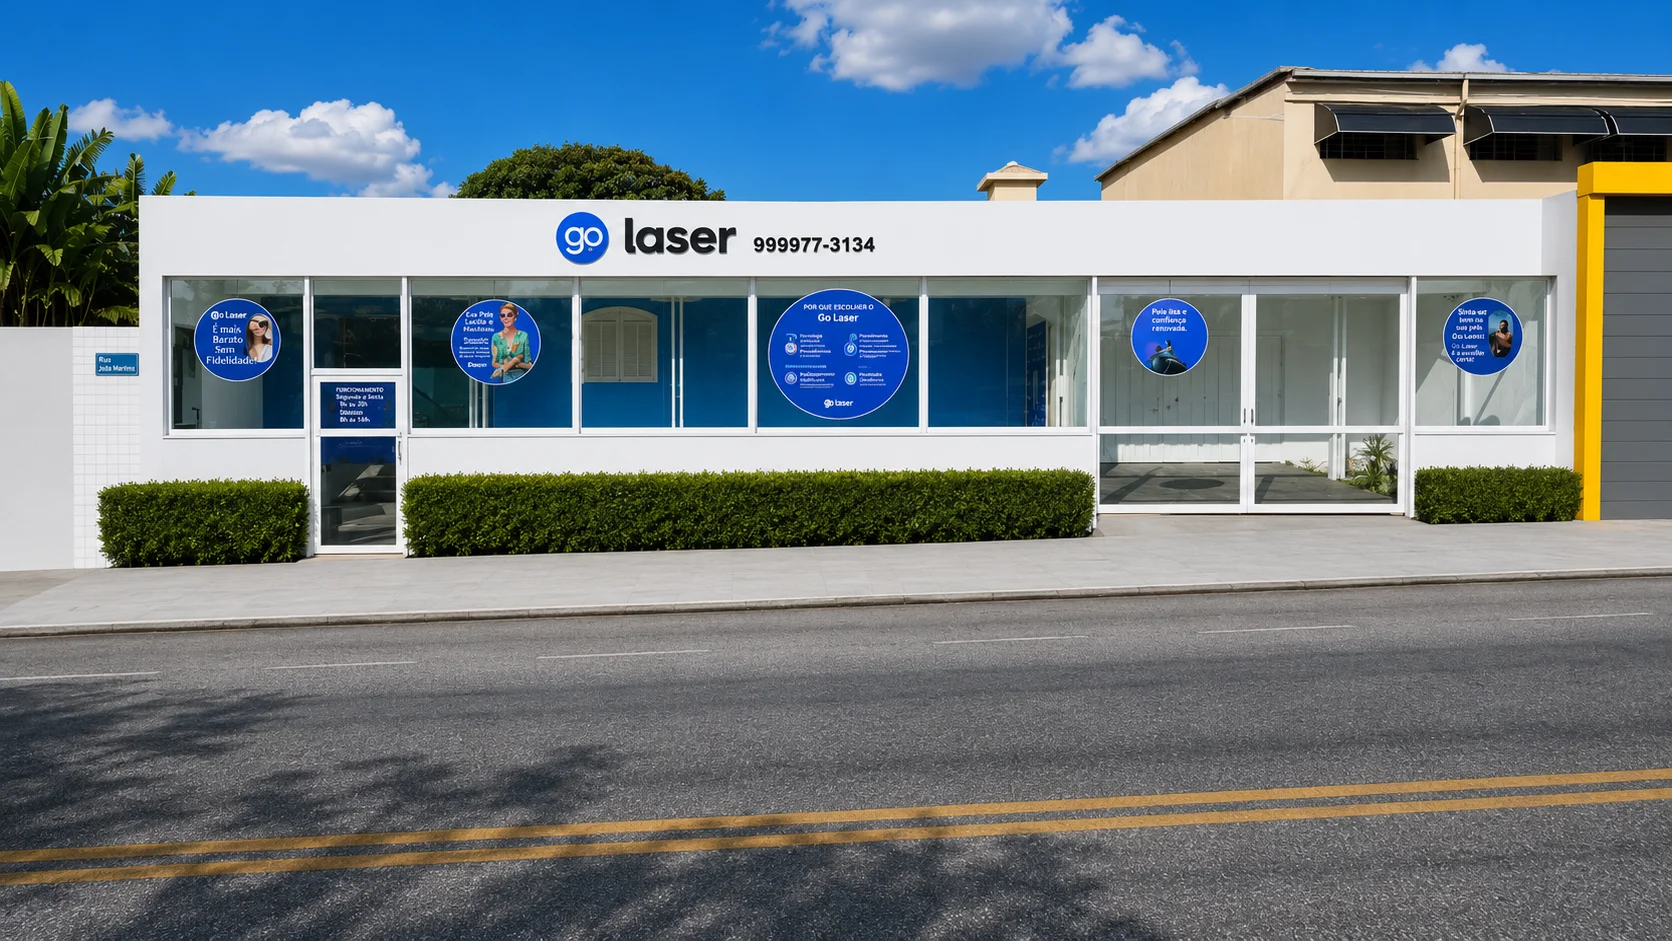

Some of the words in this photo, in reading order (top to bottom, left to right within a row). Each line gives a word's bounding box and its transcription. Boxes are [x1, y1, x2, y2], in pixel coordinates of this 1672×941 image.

[564, 225, 604, 255] go
[624, 217, 737, 254] laser
[753, 236, 876, 253] 999977-3134
[803, 303, 817, 311] POR
[817, 313, 831, 323] Go
[833, 313, 859, 323] Laser
